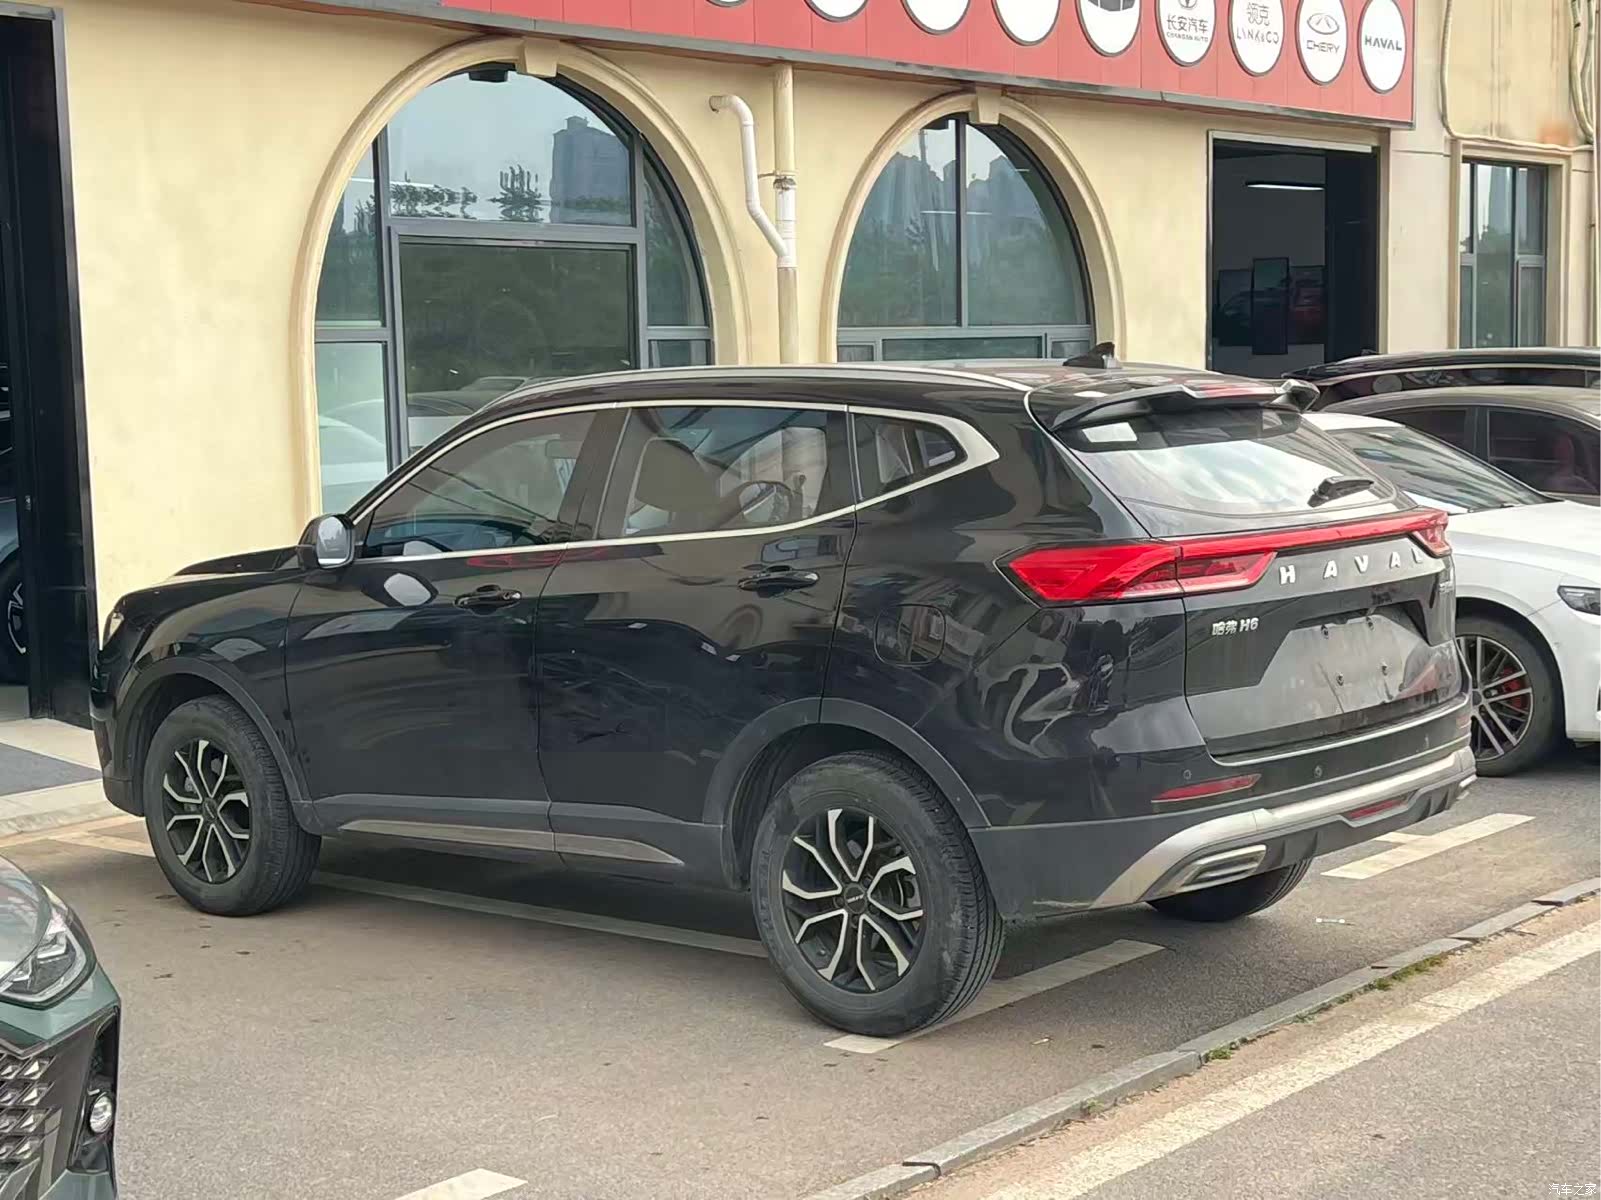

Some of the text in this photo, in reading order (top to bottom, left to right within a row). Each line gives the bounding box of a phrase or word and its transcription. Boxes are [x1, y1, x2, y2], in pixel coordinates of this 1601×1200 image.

[1167, 14, 1208, 33] 长安汽车
[1247, 2, 1270, 26] 领克
[1306, 40, 1340, 53] CHERY
[1364, 35, 1402, 51] HAVAL
[1212, 617, 1259, 636] 哈弗 H6
